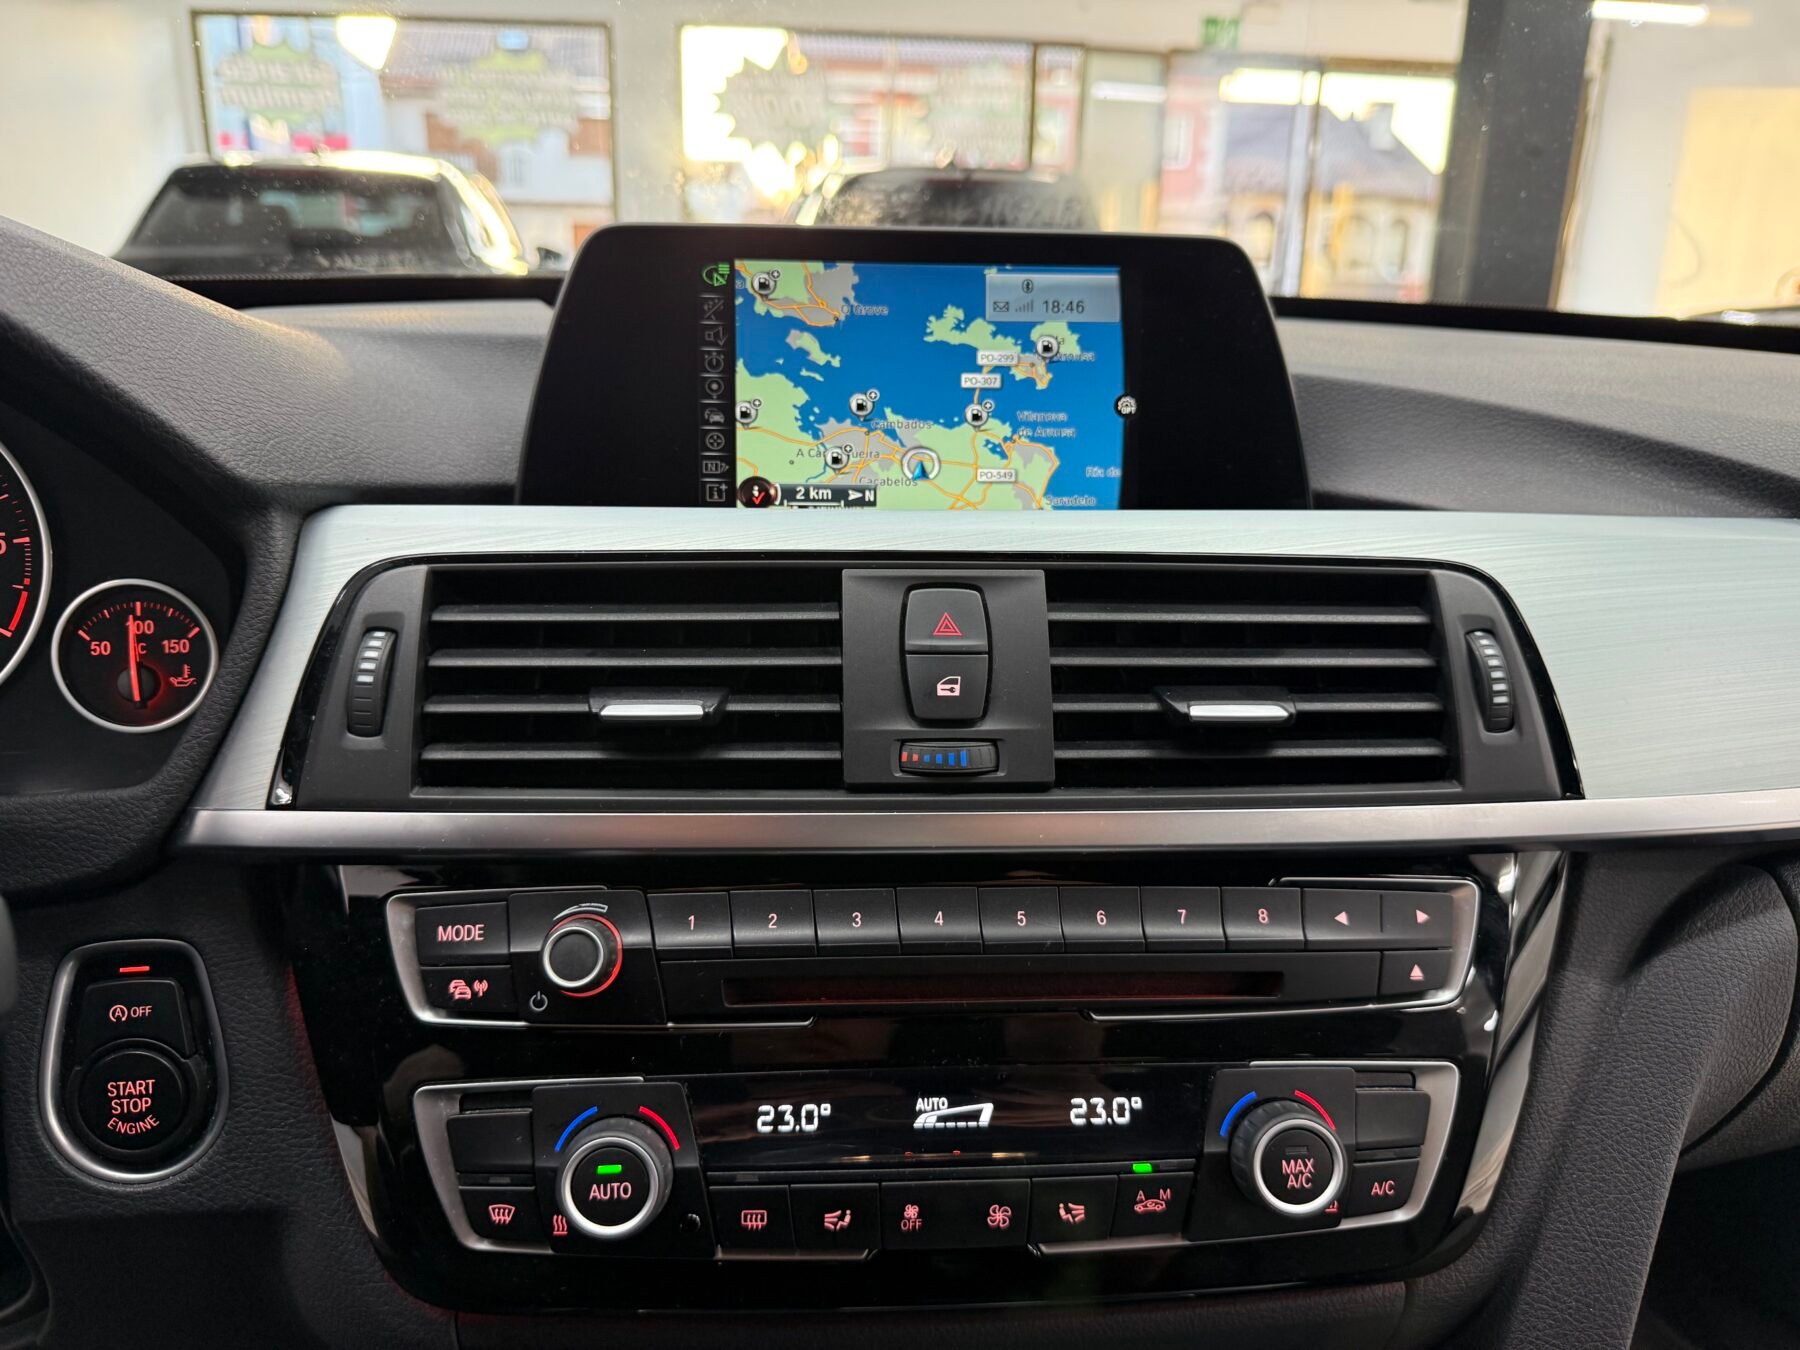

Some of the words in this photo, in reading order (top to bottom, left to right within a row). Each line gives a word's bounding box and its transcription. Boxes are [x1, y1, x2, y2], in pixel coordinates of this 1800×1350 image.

[854, 304, 888, 316] Grove
[1043, 300, 1085, 314] 18:46
[980, 353, 1015, 363] PO-299
[871, 418, 932, 430] Cambados
[796, 448, 805, 458] A
[859, 476, 919, 487] Cacabelos
[979, 470, 1013, 480] PO-549
[795, 486, 806, 500] 2
[809, 486, 832, 500] km
[864, 489, 875, 502] N
[90, 641, 111, 656] 50
[162, 639, 190, 654] 150
[687, 914, 696, 930] 1
[767, 913, 777, 929] 2
[851, 911, 862, 928] 3
[933, 911, 944, 927] 4
[1016, 911, 1027, 927] 5
[1096, 910, 1107, 926] 6
[1177, 909, 1187, 925] 7
[1258, 908, 1269, 924] 8
[438, 925, 484, 941] MODE
[131, 1006, 152, 1017] OFF
[107, 1079, 156, 1097] START
[111, 1097, 152, 1114] STOP
[915, 1097, 949, 1111] AUTO
[108, 1115, 159, 1134] ENGINE
[1281, 1158, 1315, 1174] MAX
[1287, 1172, 1314, 1189] A/C
[1371, 1181, 1394, 1195] A/C
[590, 1182, 631, 1199] AUTO
[1136, 1190, 1146, 1201] A
[1160, 1188, 1171, 1200] M
[900, 1218, 922, 1231] OFF
